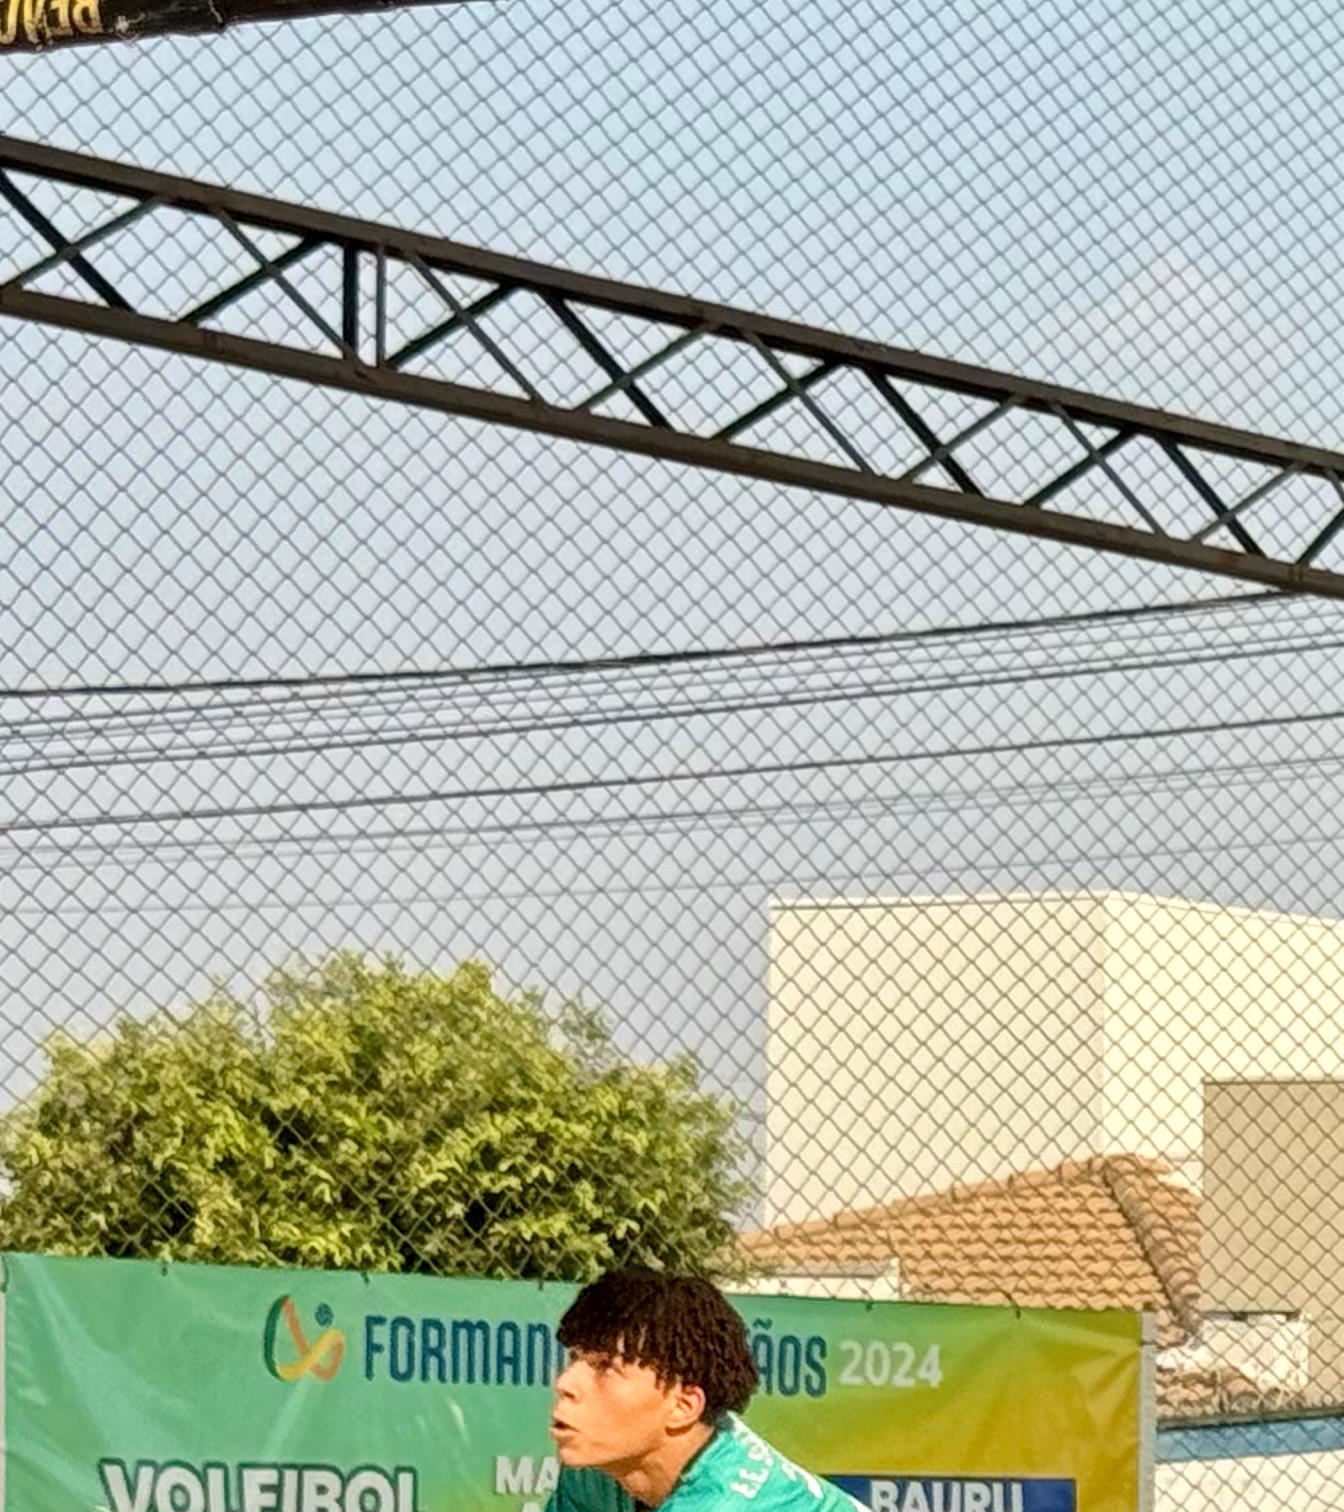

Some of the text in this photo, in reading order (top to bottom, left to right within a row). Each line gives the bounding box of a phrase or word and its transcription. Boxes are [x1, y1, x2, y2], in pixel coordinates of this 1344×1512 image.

[365, 1315, 942, 1398] FORMAN ÃOS 2024
[495, 1455, 559, 1494] MA
